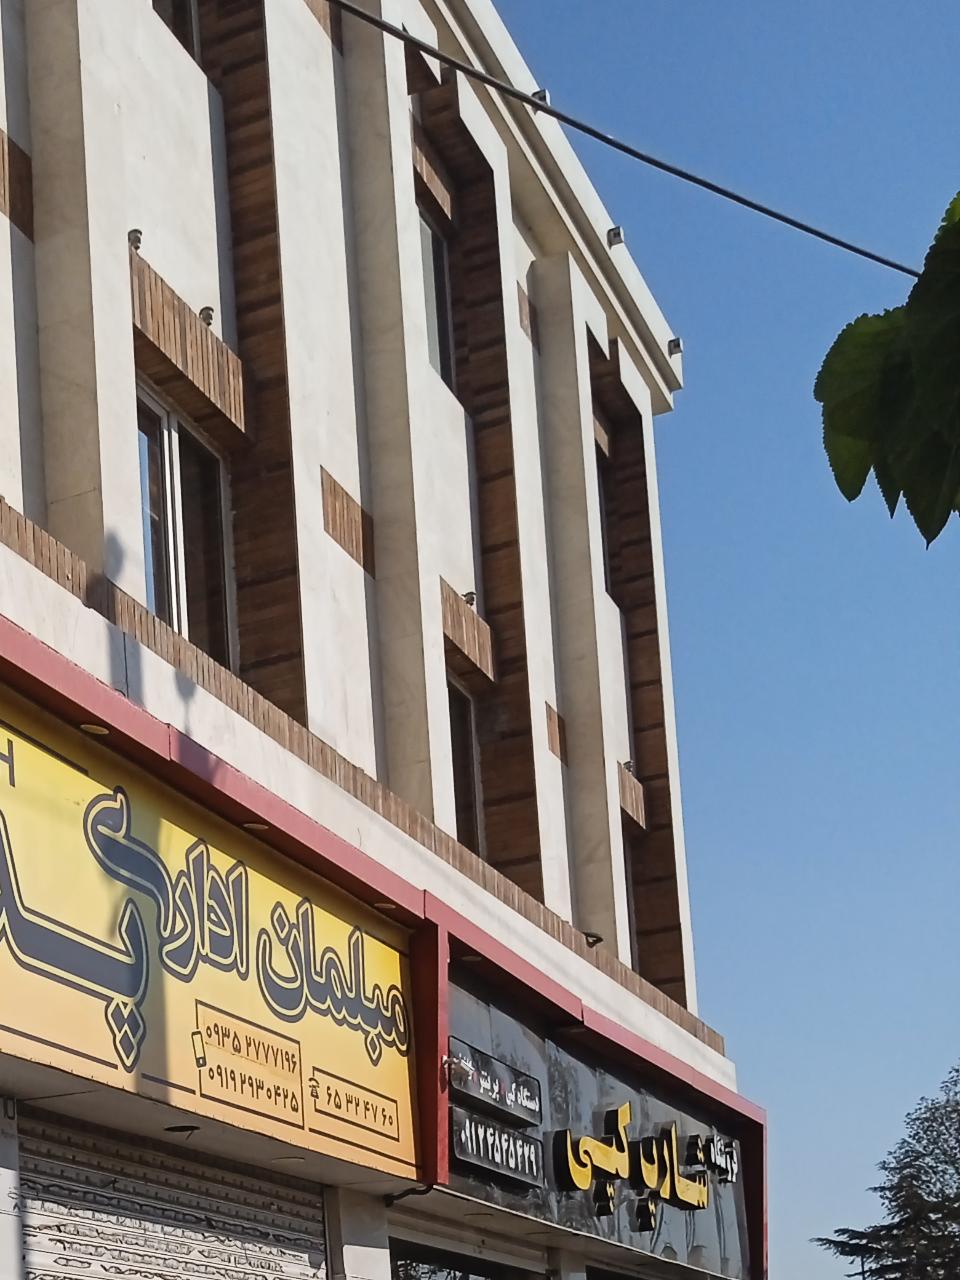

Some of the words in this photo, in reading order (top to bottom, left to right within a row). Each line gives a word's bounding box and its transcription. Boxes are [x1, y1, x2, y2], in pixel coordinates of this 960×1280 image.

[83, 785, 249, 983] اداری
[257, 897, 409, 1066] مبلمان
[205, 1022, 242, 1055] ۰۹۳۵
[245, 1035, 298, 1074] ۲۷۷۷۱۹۶
[208, 1064, 238, 1092] ۰۹۱۹
[567, 1101, 631, 1212] کپی
